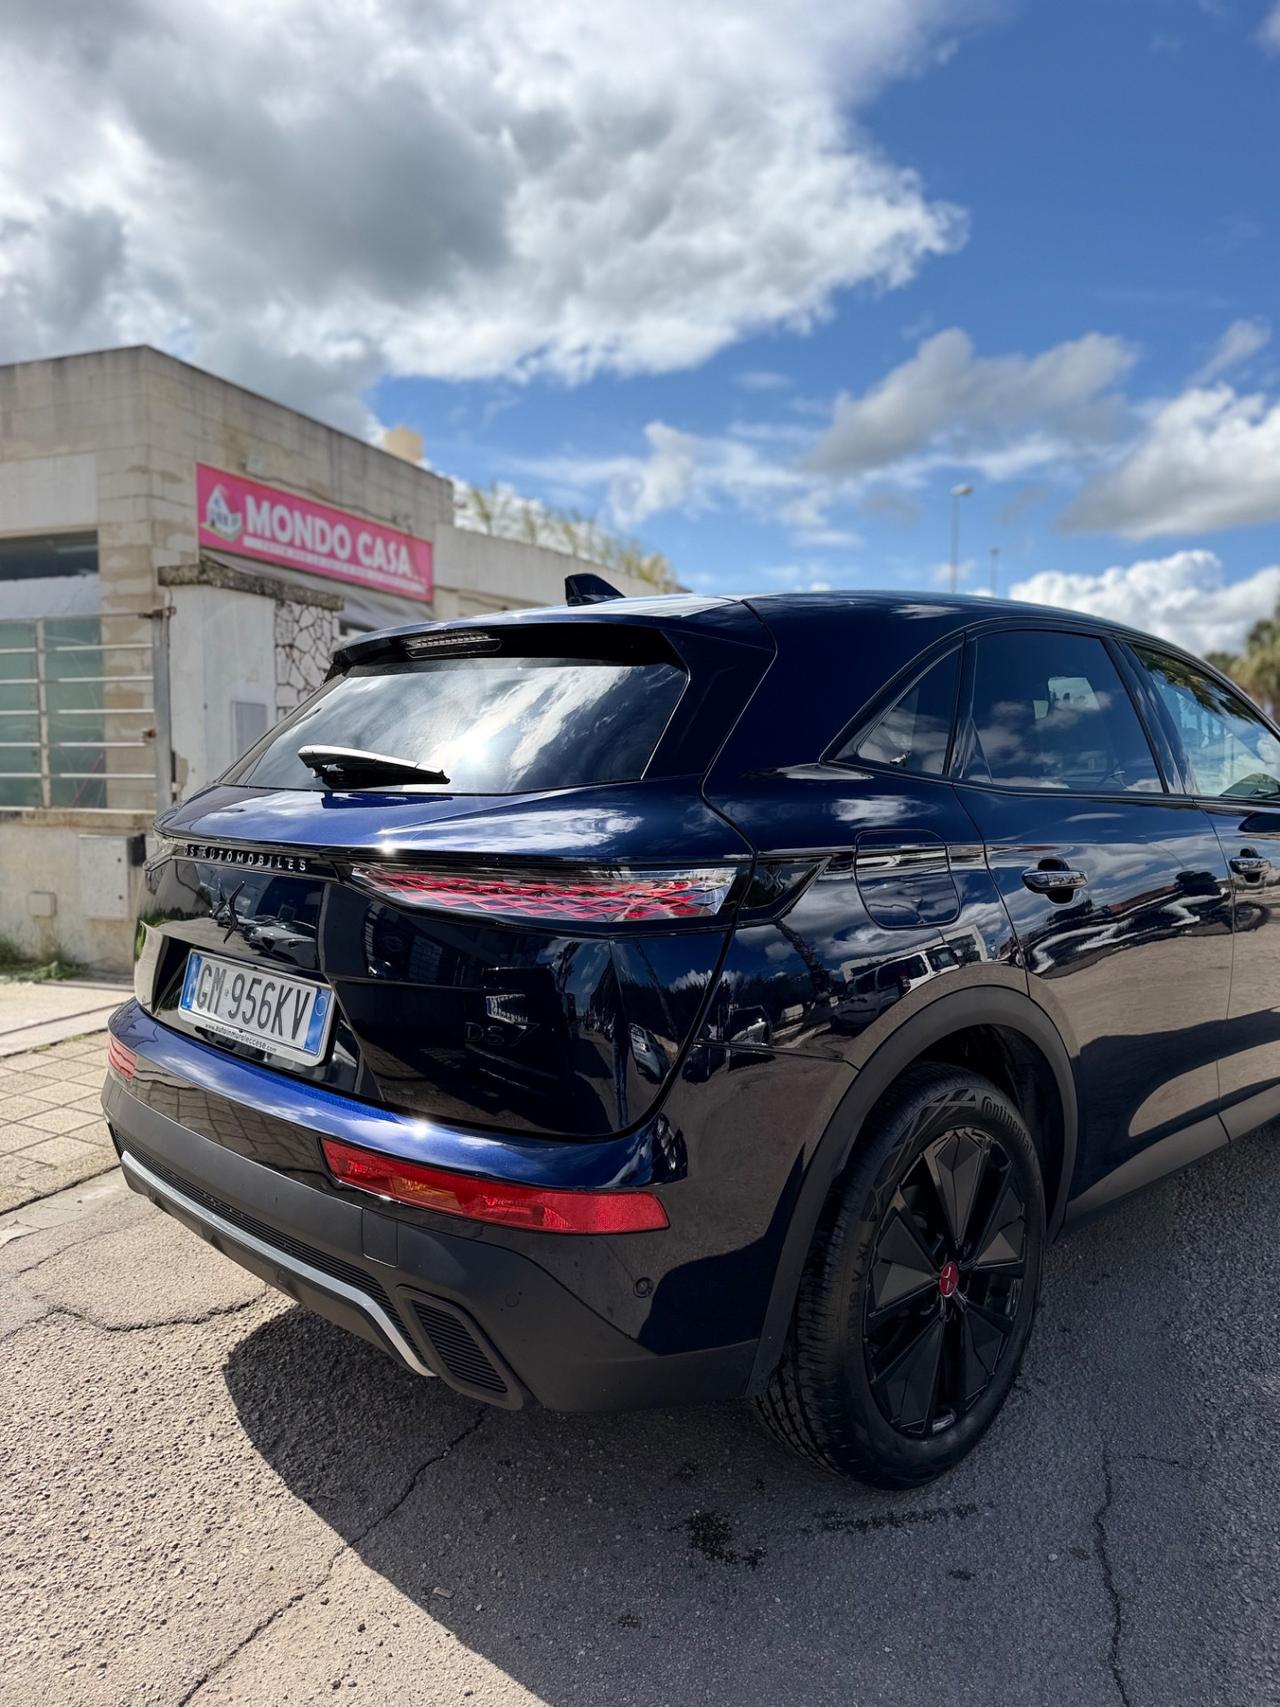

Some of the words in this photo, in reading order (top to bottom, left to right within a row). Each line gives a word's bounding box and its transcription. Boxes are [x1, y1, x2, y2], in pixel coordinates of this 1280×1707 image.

[245, 496, 351, 559] MONDO
[357, 533, 413, 577] CASA
[197, 846, 306, 871] AUTOMOBILES
[228, 973, 311, 1041] 956KV
[464, 1021, 505, 1046] DS
